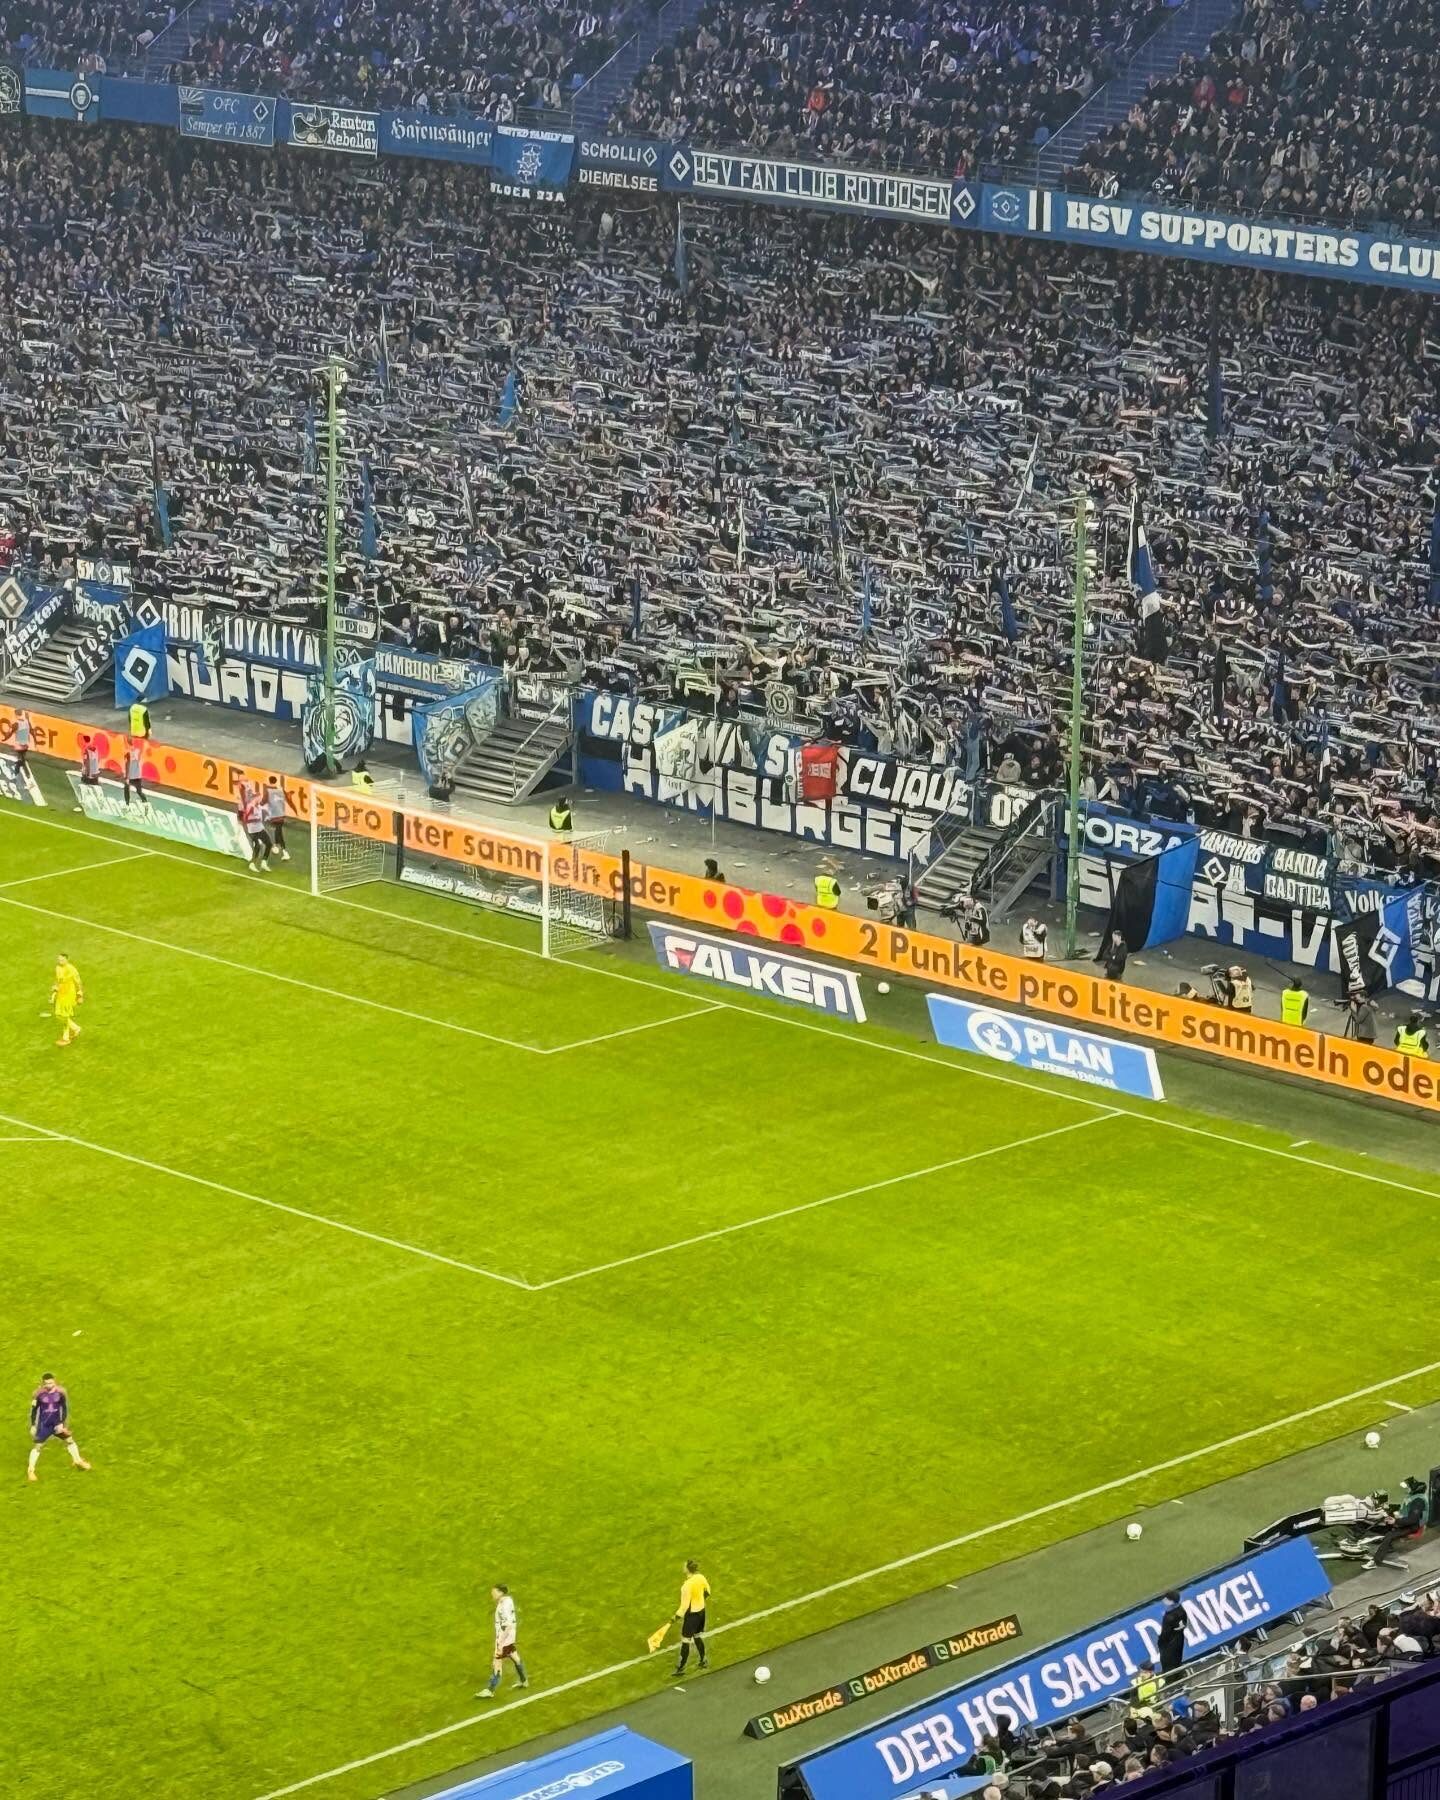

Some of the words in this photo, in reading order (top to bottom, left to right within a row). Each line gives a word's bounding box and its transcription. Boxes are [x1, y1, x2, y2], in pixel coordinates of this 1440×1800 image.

[578, 168, 658, 192] DIEMELSEE
[581, 141, 641, 164] SCHOLLI
[692, 155, 732, 187] HSV
[740, 162, 778, 194] FAN
[785, 168, 838, 200] CLUB
[844, 173, 951, 216] ROTHOSEN
[1066, 200, 1133, 236] HSV
[1140, 211, 1360, 267] SUPPORTERS
[163, 602, 204, 642] IRON
[224, 614, 304, 663] LOYALTY
[203, 760, 220, 791] 2
[334, 800, 382, 832] pro
[393, 811, 454, 850] iter
[850, 758, 970, 817] CLIQUE
[665, 934, 848, 1014] FALKEN
[859, 923, 879, 957] 2
[889, 931, 1009, 991] Punkte
[1018, 972, 1079, 1009] pro
[1091, 981, 1171, 1032] Liter
[1181, 1014, 1349, 1078] sammeln
[1027, 1028, 1115, 1075] PLAN
[949, 1620, 1017, 1657] buXtrade
[864, 1653, 927, 1692] buXtrade
[875, 1713, 967, 1785] DER
[956, 1673, 1039, 1748] HSV
[1040, 1630, 1139, 1709] SAGT
[1135, 1570, 1271, 1664] DNKE!
[773, 1690, 844, 1729] buXtrade
